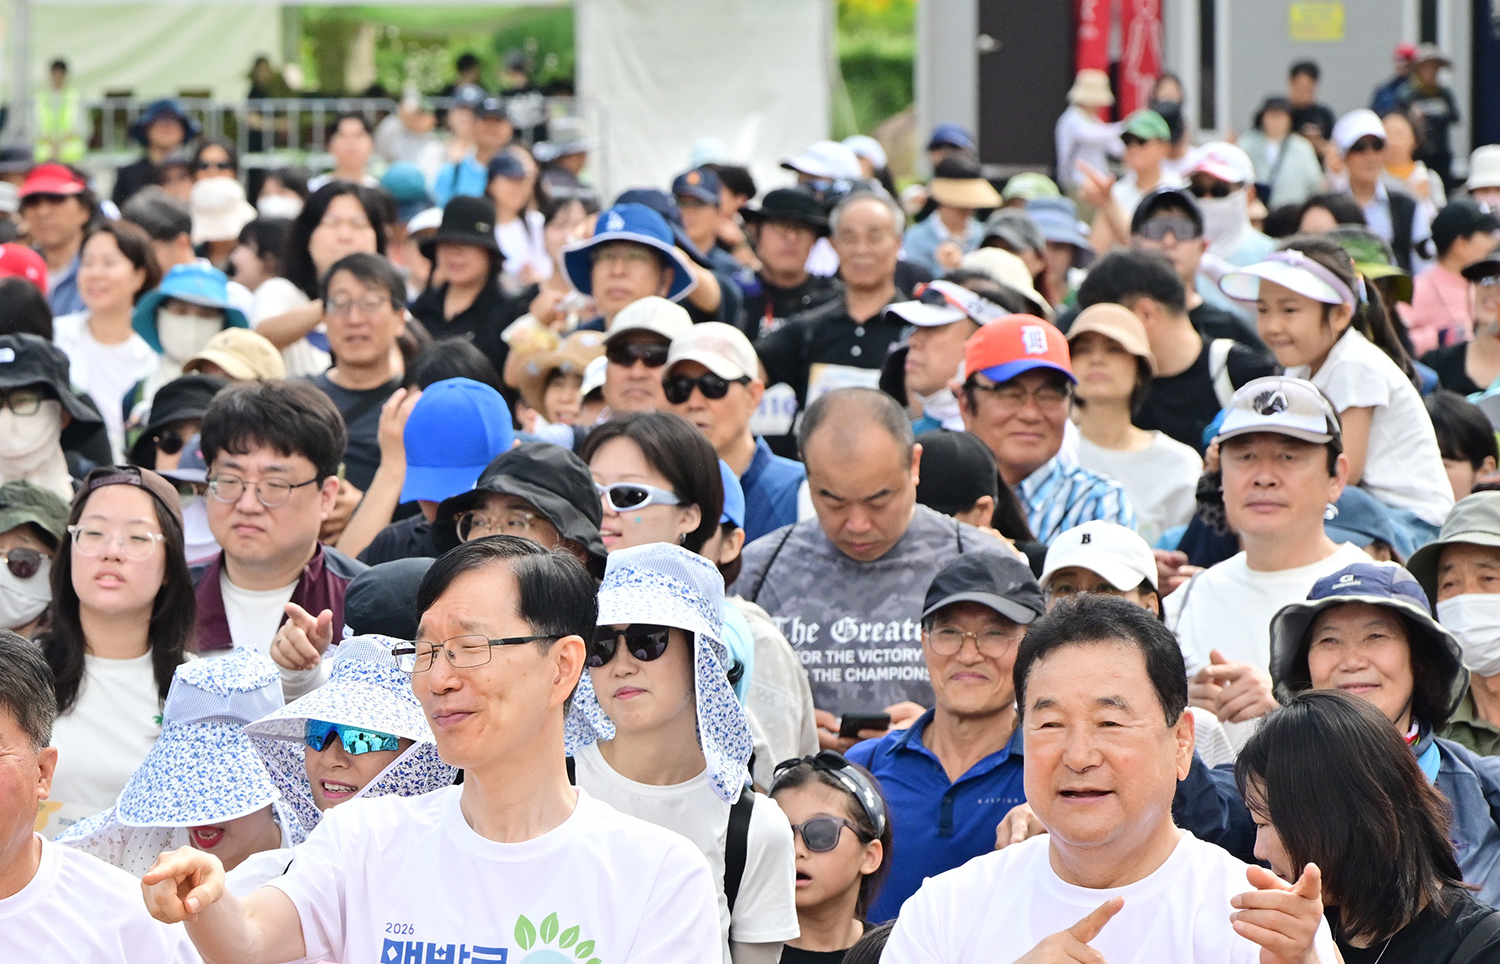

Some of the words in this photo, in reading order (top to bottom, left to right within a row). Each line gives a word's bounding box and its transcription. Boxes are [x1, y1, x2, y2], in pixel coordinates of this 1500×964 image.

[826, 650, 855, 664] THE
[858, 648, 924, 664] VICTORY
[813, 667, 842, 682] THE
[385, 922, 415, 935] 2026
